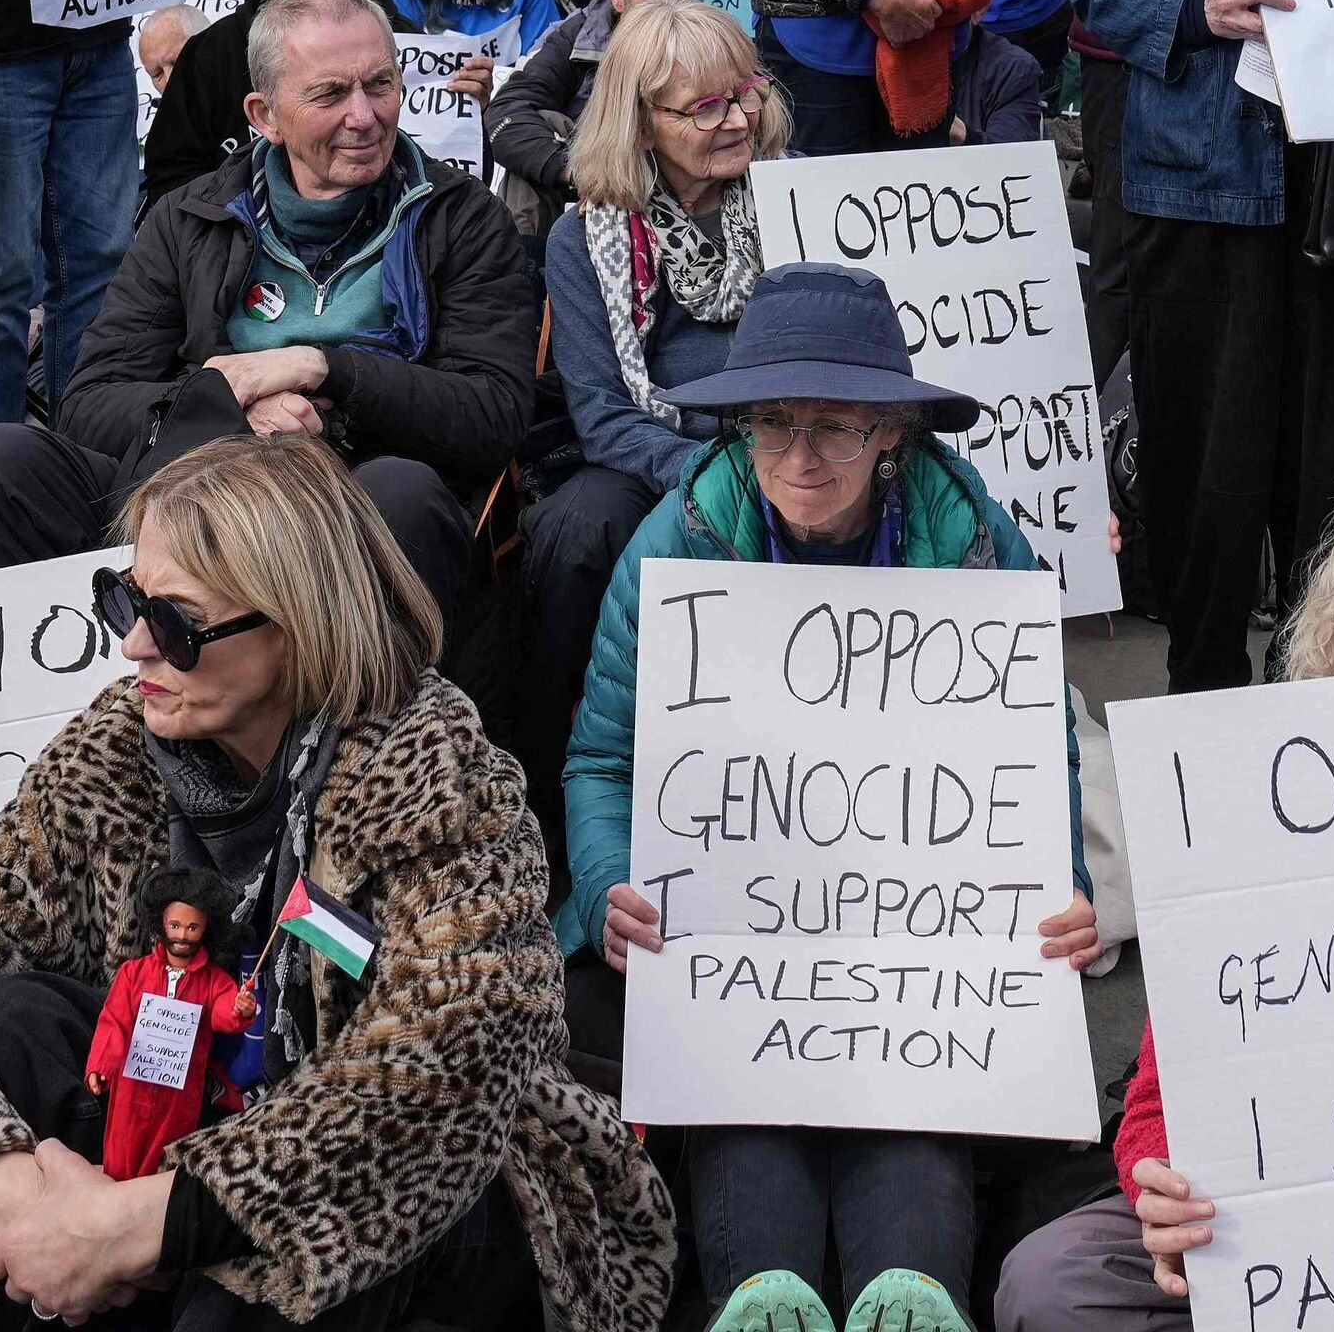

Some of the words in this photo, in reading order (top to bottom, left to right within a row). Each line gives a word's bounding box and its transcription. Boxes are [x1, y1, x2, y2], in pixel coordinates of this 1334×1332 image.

[789, 187, 806, 262] I
[835, 174, 1037, 259] OPPOSE
[661, 590, 731, 711] I
[784, 603, 1056, 712] OPPOSE
[657, 750, 1036, 851] GENOCIDE
[1173, 751, 1191, 848] I
[643, 868, 695, 943] I
[745, 872, 1043, 941] SUPPORT
[690, 954, 1043, 1010] PALESTINE
[139, 1018, 192, 1036] GENOCIDE
[156, 1008, 188, 1022] OPPOSE
[131, 1052, 187, 1072] PALESTINE
[146, 1043, 188, 1059] SUPPORT
[751, 1018, 996, 1072] ACTION
[132, 1066, 180, 1085] ACTION
[1251, 1096, 1265, 1181] I
